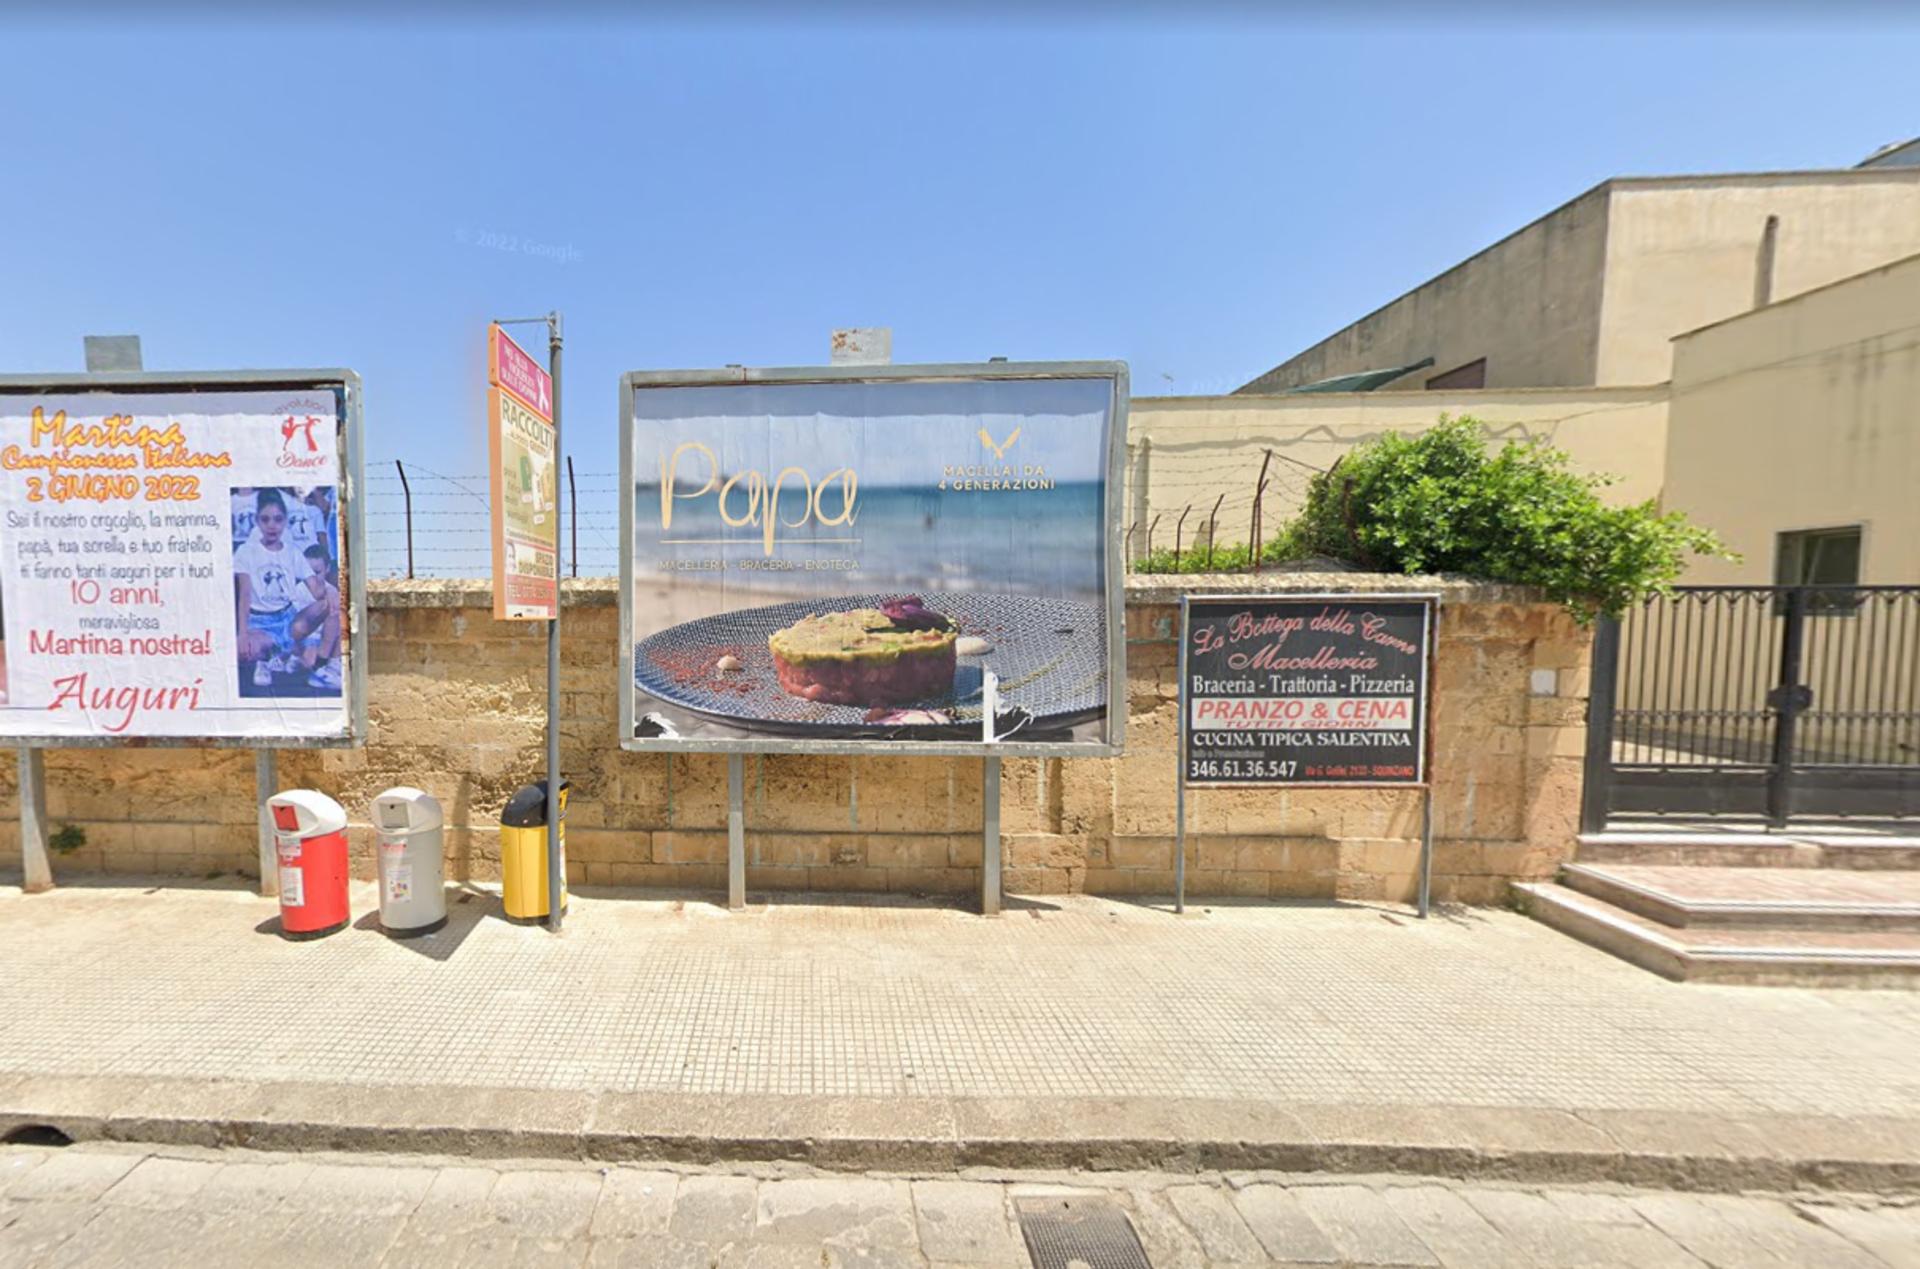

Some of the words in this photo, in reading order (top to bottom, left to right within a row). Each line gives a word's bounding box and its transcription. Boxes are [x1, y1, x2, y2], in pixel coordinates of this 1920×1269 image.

[31, 405, 186, 448] Martina
[144, 444, 232, 469] Italiana
[1023, 465, 1045, 476] DA
[27, 477, 43, 502] 2
[48, 474, 140, 502] GIUGNO
[144, 475, 201, 500] 2022
[938, 479, 946, 490] 4
[953, 479, 1055, 491] GENERAZIONI
[659, 441, 863, 557] Papa
[7, 511, 30, 529] Sei
[33, 511, 41, 528] il
[43, 514, 87, 528] nostro
[149, 511, 161, 528] la
[165, 514, 220, 530] mamma,
[58, 539, 79, 553] tua
[83, 535, 126, 553] sorella
[129, 541, 138, 553] e
[142, 539, 163, 553] tuo
[167, 535, 212, 553] fratello
[34, 562, 72, 579] fanno
[76, 564, 107, 579] tanti
[110, 565, 150, 584] auguri
[154, 565, 176, 584] per
[188, 563, 214, 579] tuoi
[740, 560, 793, 571] BRACERIA
[805, 559, 860, 570] ENOTECA
[71, 579, 101, 605] 10
[109, 582, 165, 607] anni,
[79, 612, 160, 634] meravigliosa
[1194, 625, 1225, 656] La
[1228, 611, 1304, 643] Bottega
[1310, 607, 1355, 636] della
[1360, 611, 1417, 655] Carne
[30, 629, 123, 656] Martina
[130, 629, 211, 656] nostra!
[1228, 643, 1379, 670] Macelleria
[1193, 675, 1256, 694] Braceria
[1269, 675, 1337, 694] Trattoria
[1350, 674, 1415, 694] Pizzeria
[47, 672, 203, 733] Auguri
[1197, 700, 1305, 719] PRANZO
[1311, 702, 1329, 719] &
[1337, 700, 1407, 719] CENA
[1225, 720, 1285, 729] TUTTI
[1288, 720, 1297, 729] I
[1301, 720, 1380, 729] GIORNI
[1193, 733, 1256, 747] CUCINA
[1258, 732, 1314, 746] TIPICA
[1317, 732, 1412, 747] SALENTINA
[1191, 760, 1297, 778] 346.61.36.547
